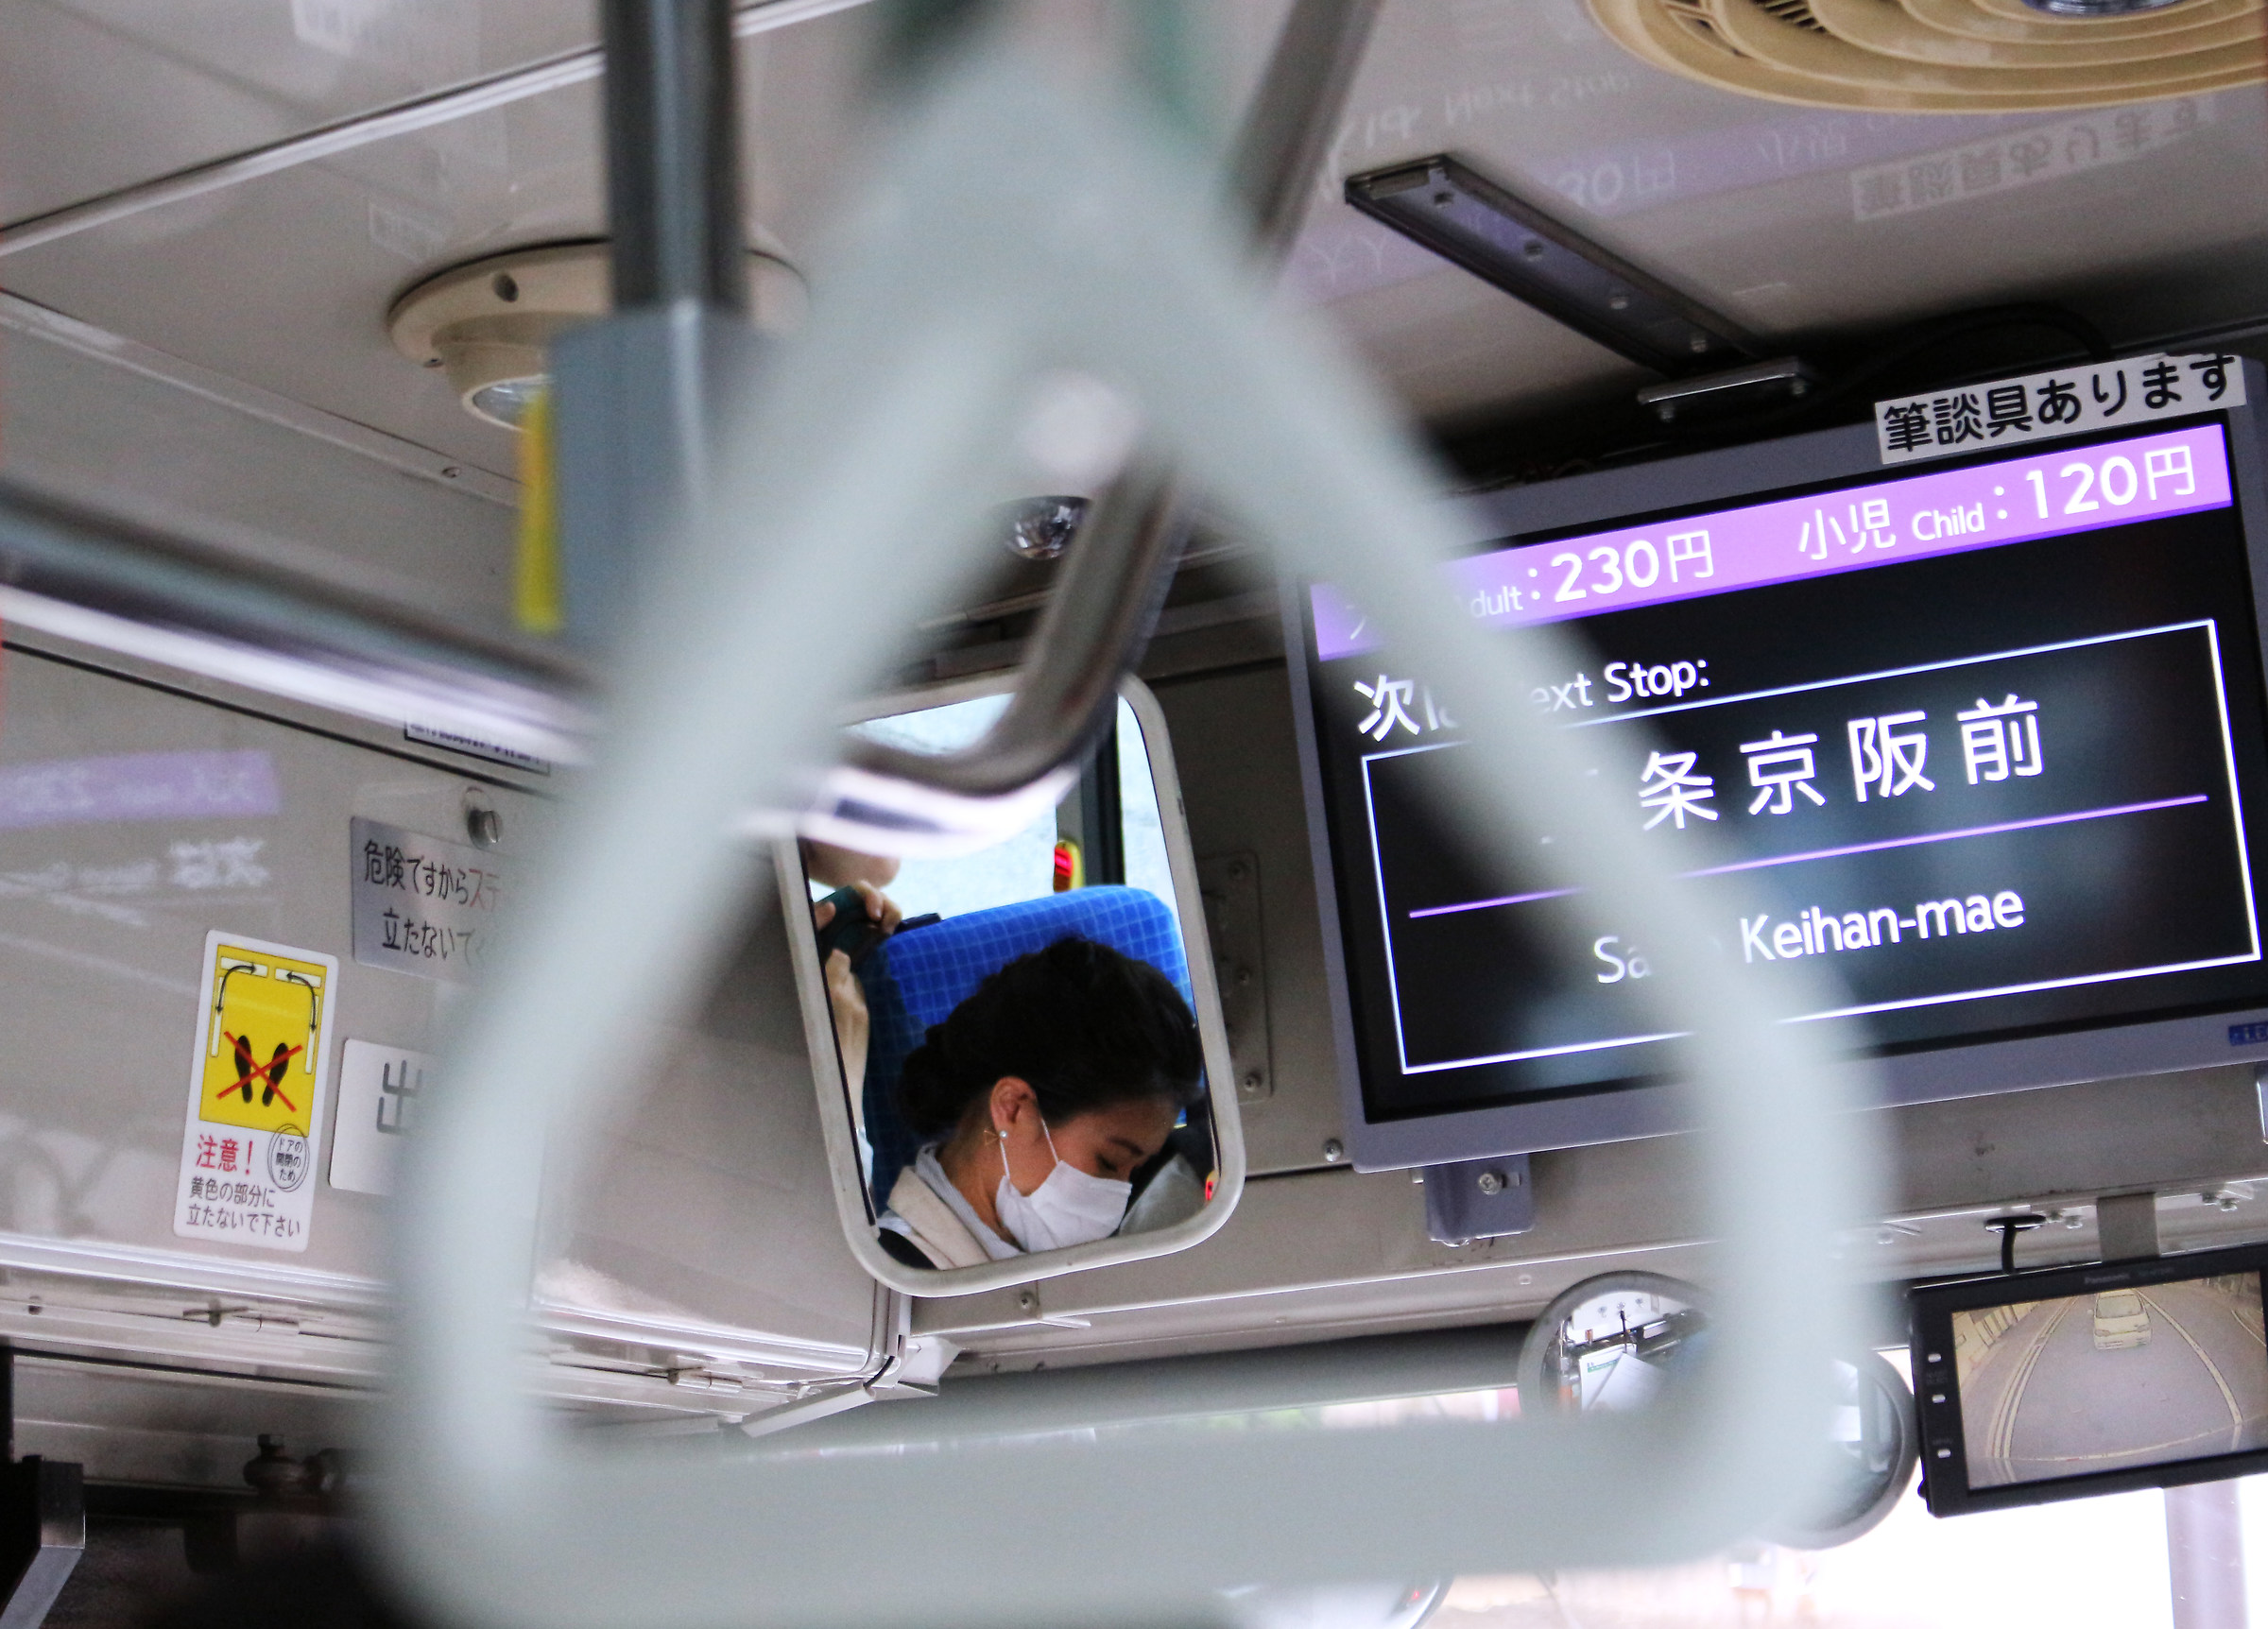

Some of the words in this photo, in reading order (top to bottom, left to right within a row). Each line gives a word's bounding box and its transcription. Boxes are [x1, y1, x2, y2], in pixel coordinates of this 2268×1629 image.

[1883, 352, 2236, 453] 筆談具あります
[1796, 498, 1897, 559] 小児
[1523, 672, 1594, 714] ext
[1603, 659, 1710, 704] Stop:
[1597, 693, 2044, 832] 条京阪前
[1738, 889, 2025, 963] Keihan-mae
[190, 1175, 276, 1208] 黄色の部分に
[279, 1168, 296, 1182] ため
[186, 1203, 301, 1238] 立たないで下さい
